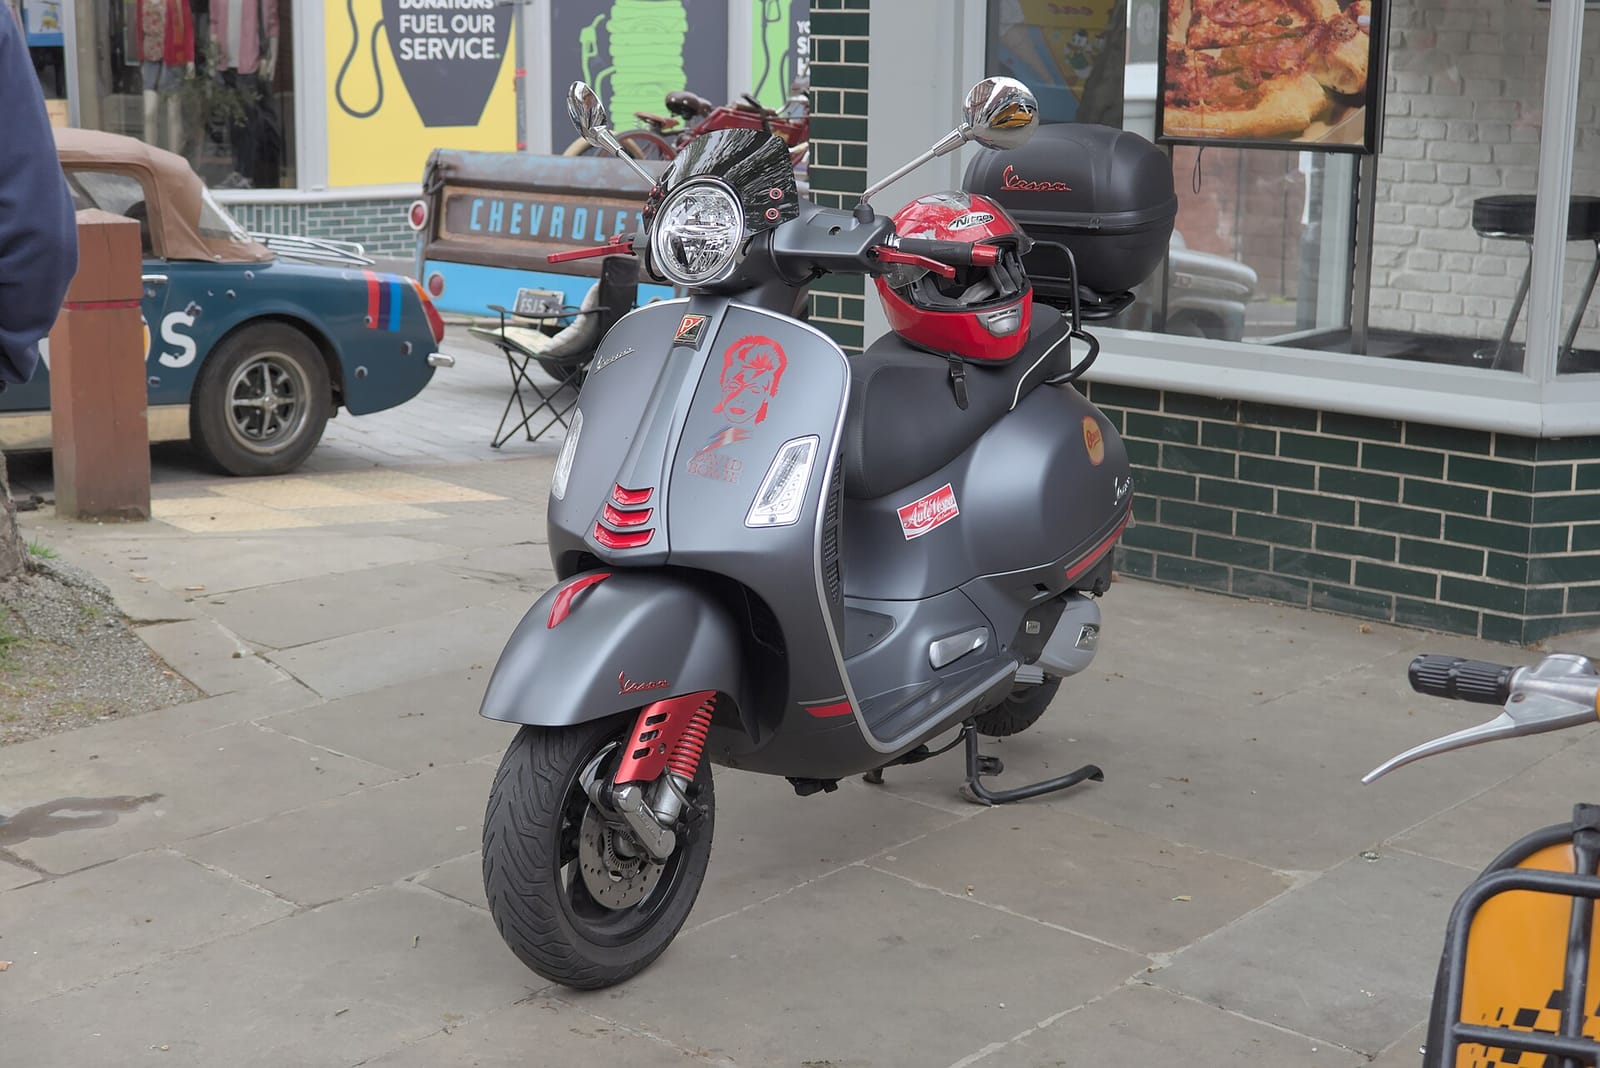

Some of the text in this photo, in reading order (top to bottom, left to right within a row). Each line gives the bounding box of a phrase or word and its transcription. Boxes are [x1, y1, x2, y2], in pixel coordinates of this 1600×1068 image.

[399, 14, 496, 34] FUEL OUR
[399, 37, 501, 60] SERVICE.
[1000, 164, 1072, 192] Vespa
[955, 213, 990, 229] Nitro
[617, 669, 671, 696] Vespa
